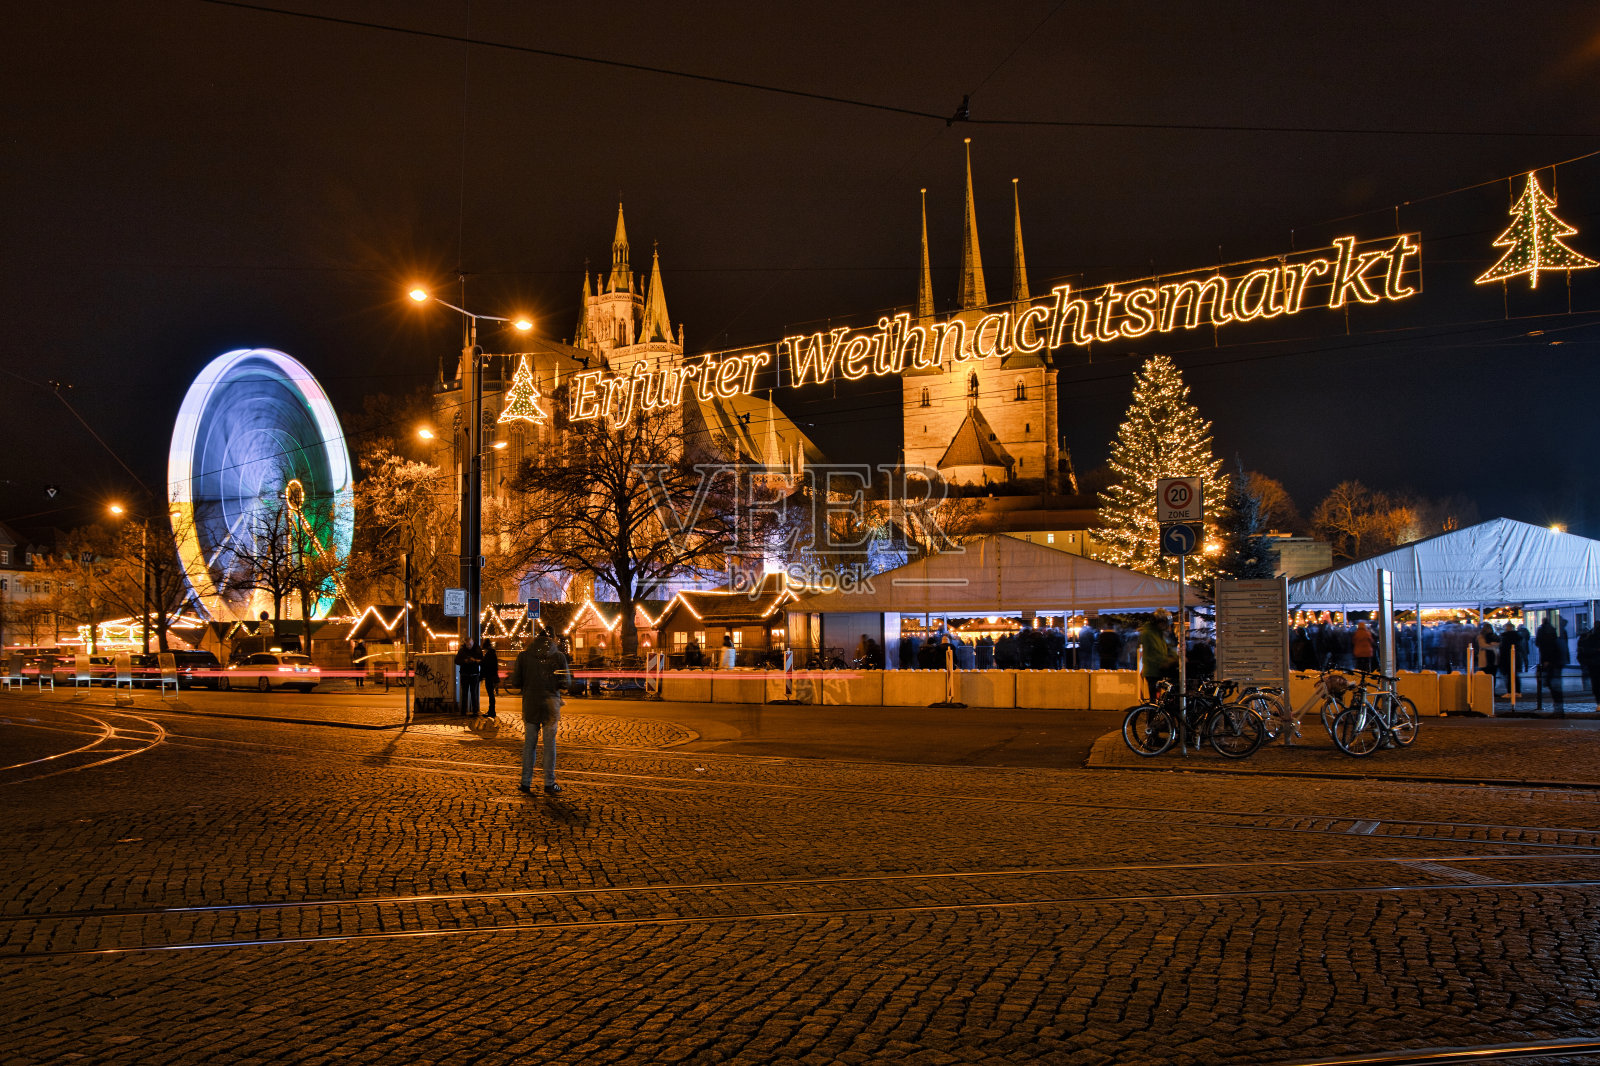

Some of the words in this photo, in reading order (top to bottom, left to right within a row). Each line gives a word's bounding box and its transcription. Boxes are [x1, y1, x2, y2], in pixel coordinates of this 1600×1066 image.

[569, 350, 770, 429] Erfurter
[783, 234, 1419, 388] Weihnachtsmarkt
[1170, 488, 1188, 502] 20
[1168, 510, 1190, 519] ZONE
